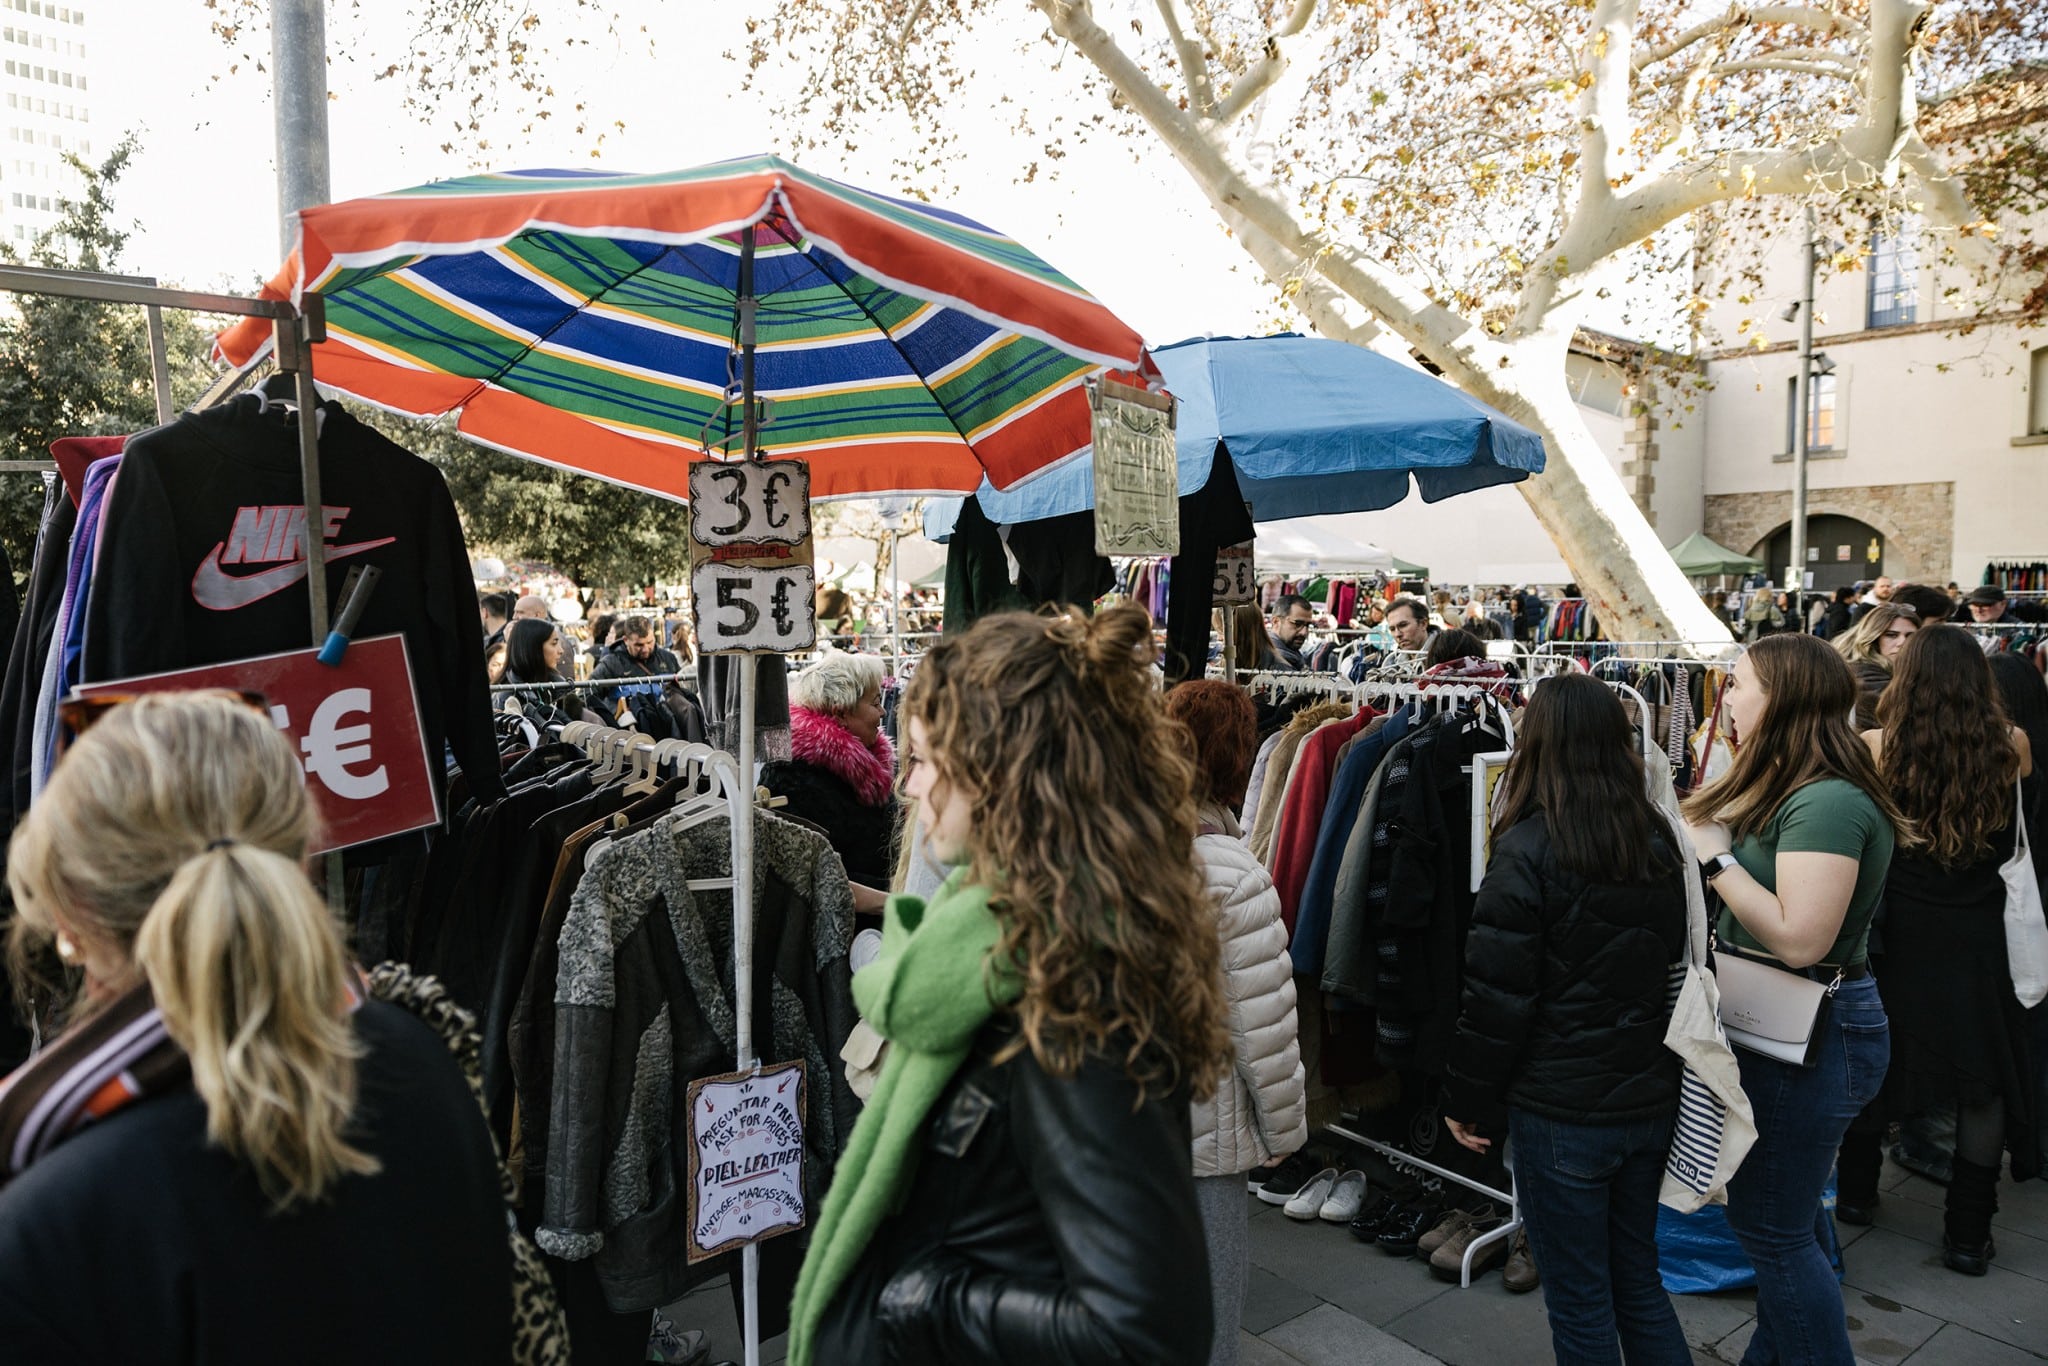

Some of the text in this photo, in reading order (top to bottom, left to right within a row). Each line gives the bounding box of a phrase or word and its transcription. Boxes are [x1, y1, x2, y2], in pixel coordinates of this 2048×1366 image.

[699, 1096, 803, 1149] PREGUNTAR PRECIOS
[714, 1113, 791, 1152] ASK FOR PRICES
